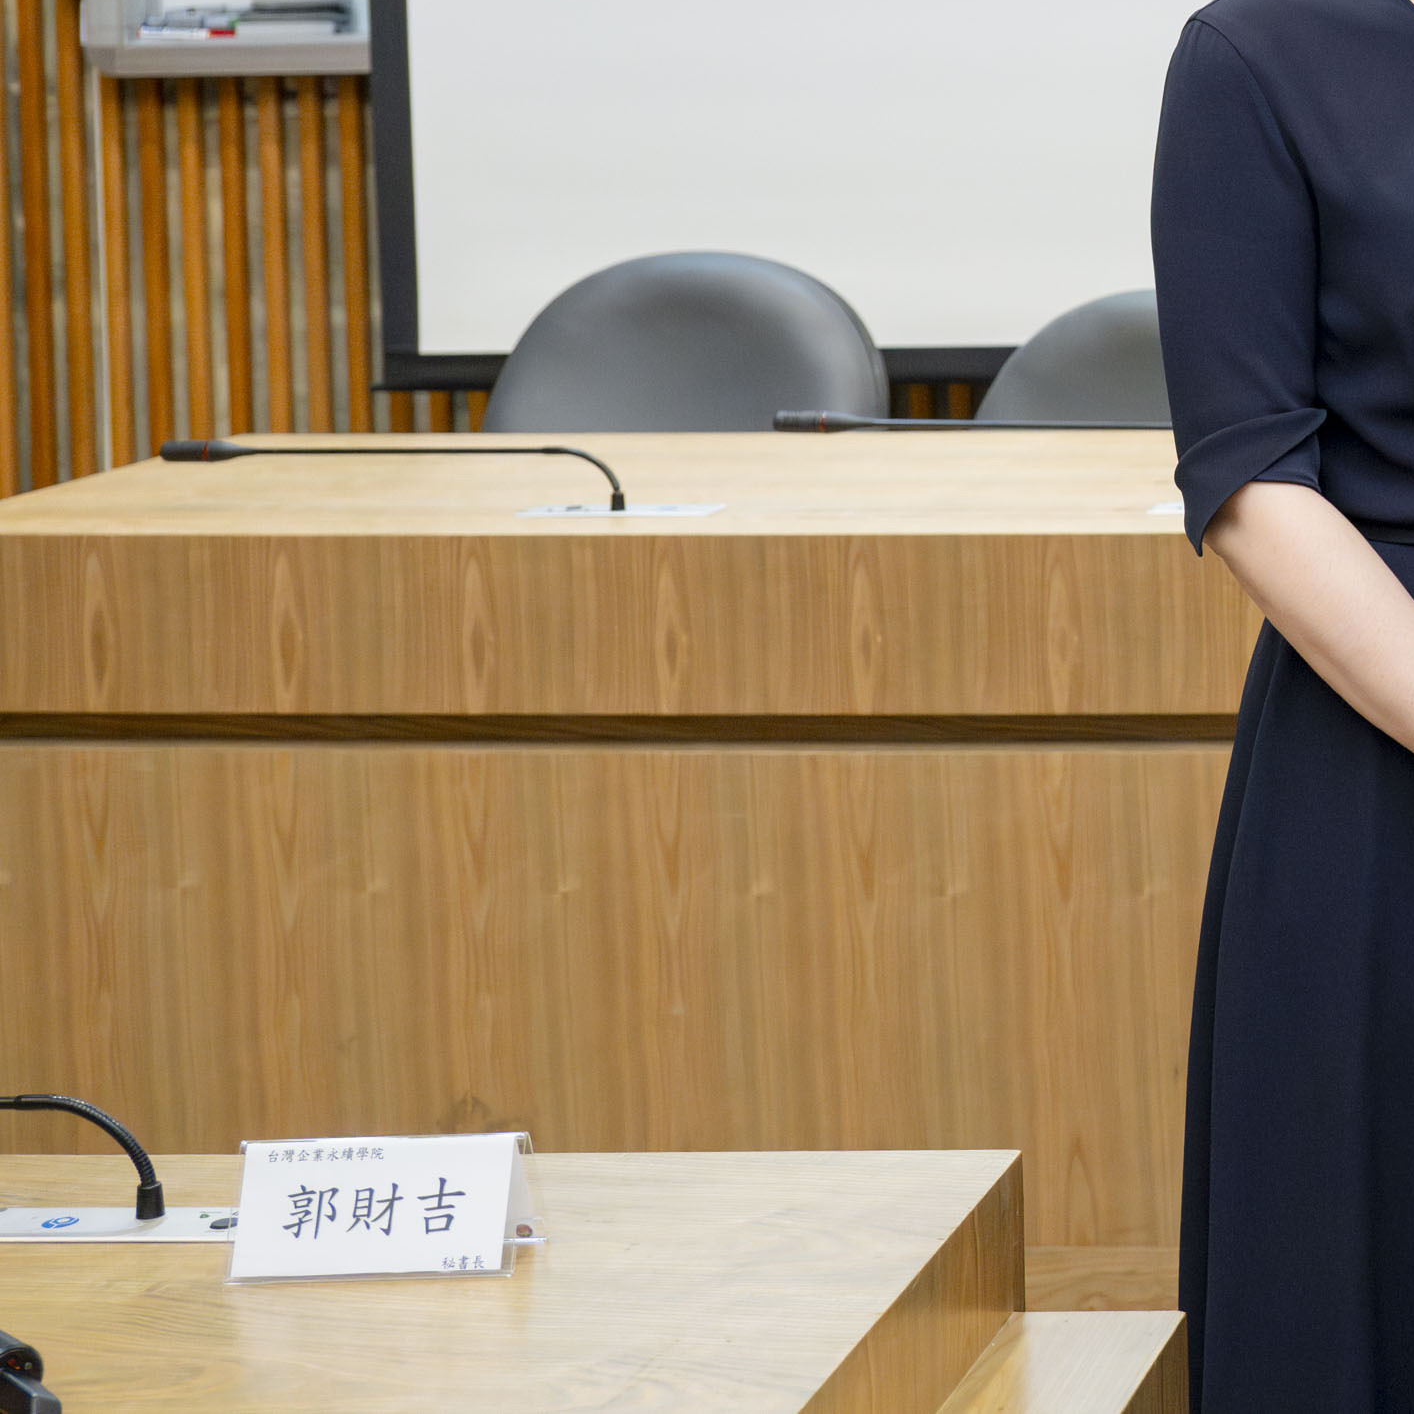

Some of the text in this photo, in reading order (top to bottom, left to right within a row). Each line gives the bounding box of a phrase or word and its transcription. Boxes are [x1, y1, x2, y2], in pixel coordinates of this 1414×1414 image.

[268, 1147, 384, 1163] 台灣企業永續學院
[282, 1177, 466, 1240] 郭財吉
[442, 1255, 485, 1270] 秘書長
